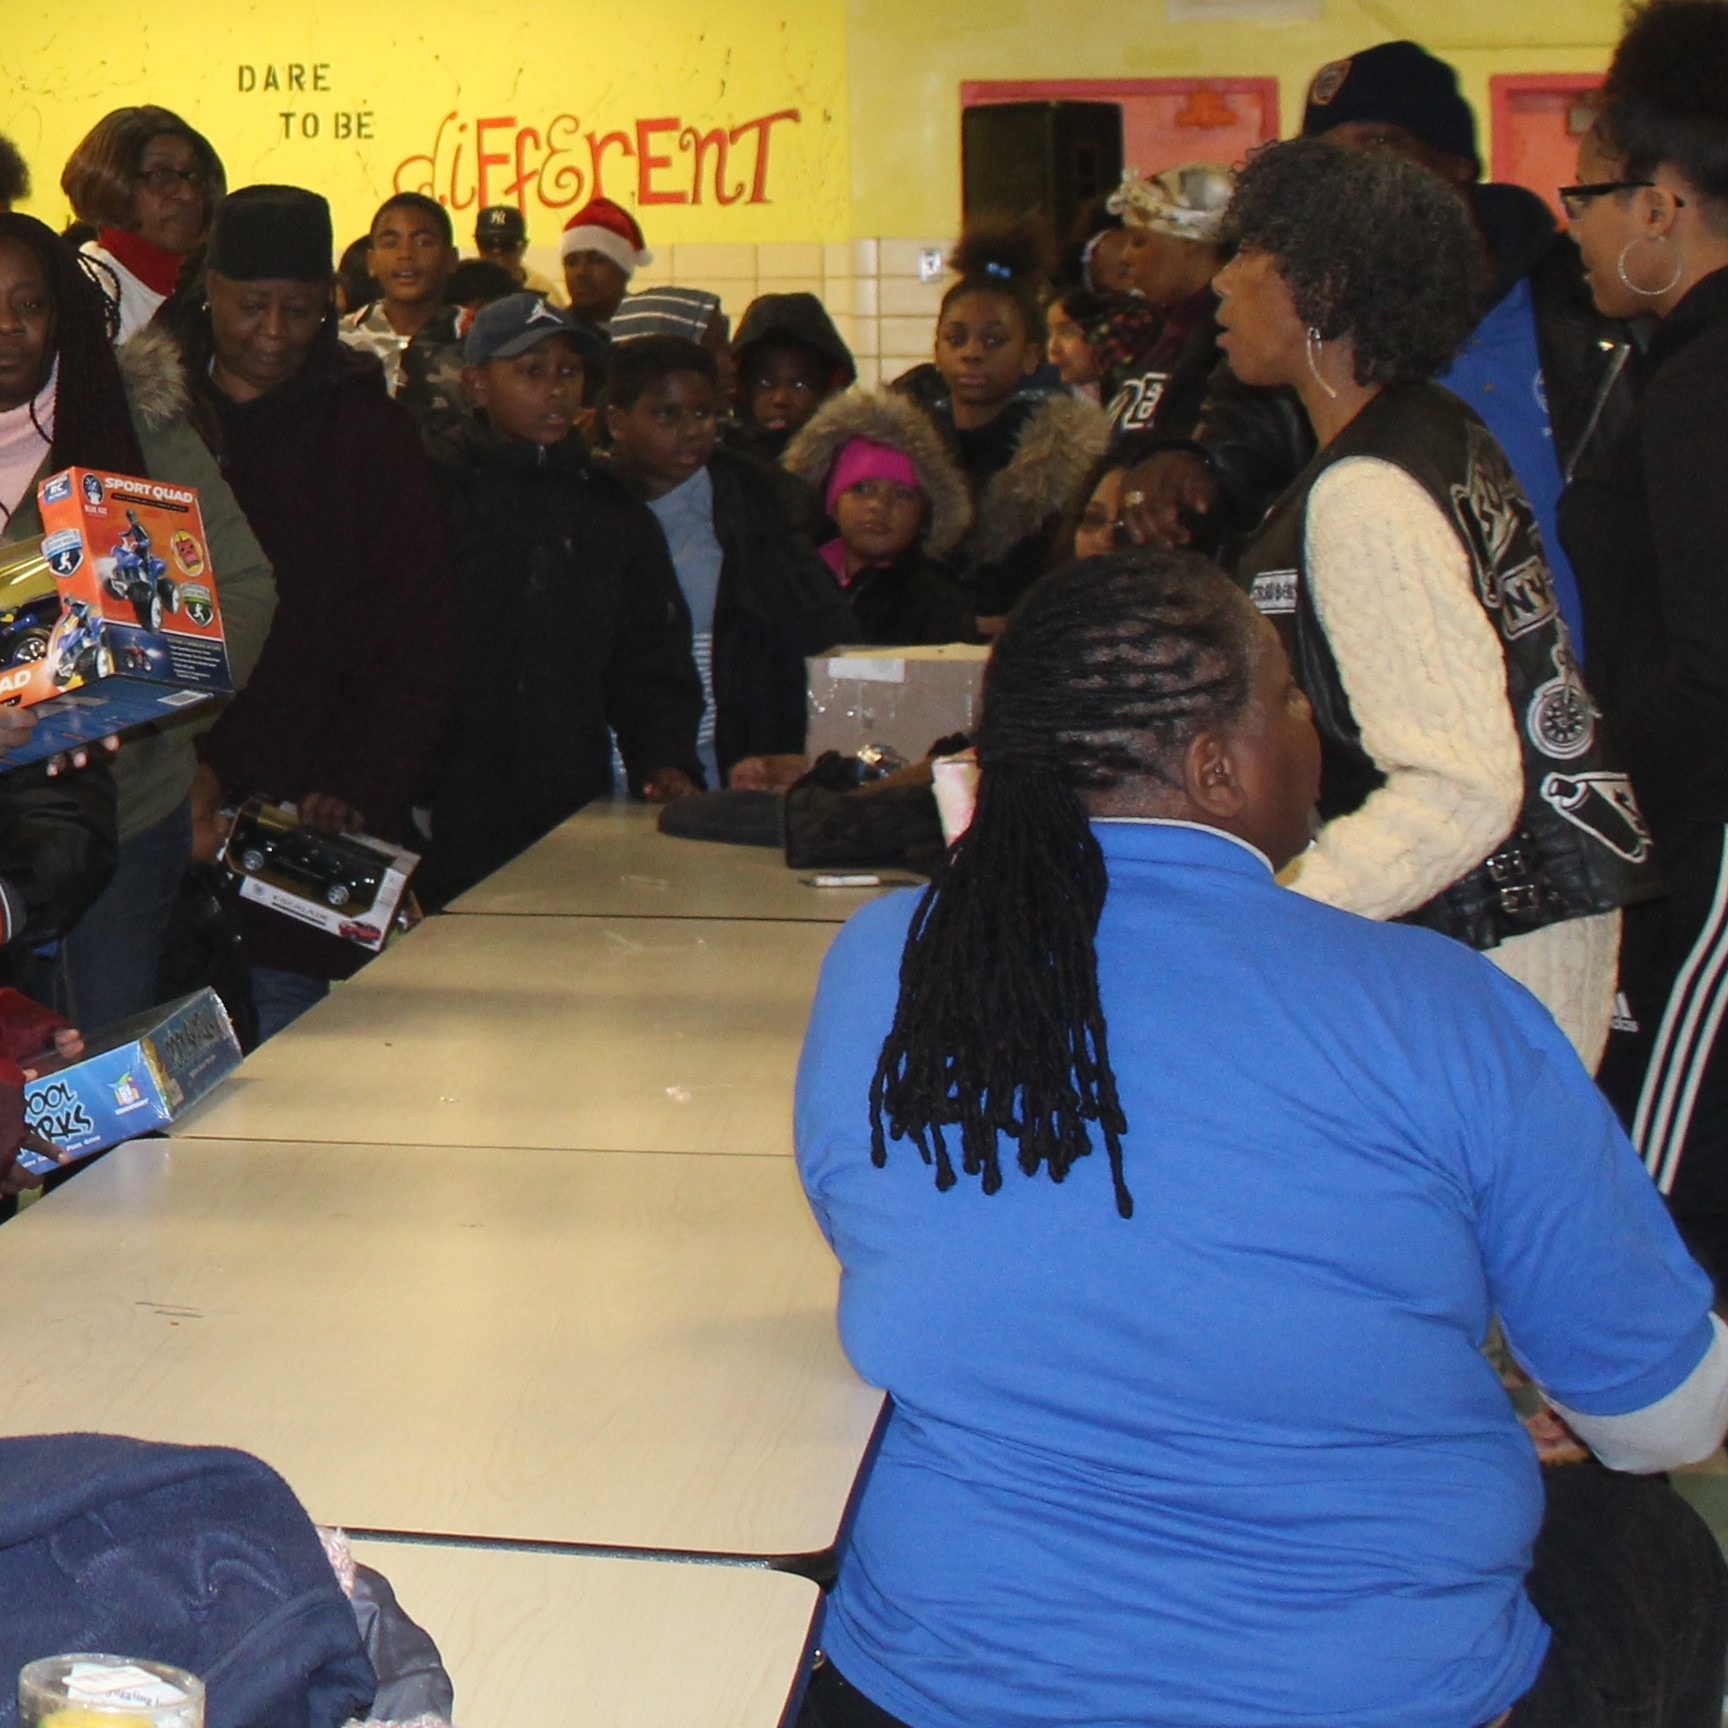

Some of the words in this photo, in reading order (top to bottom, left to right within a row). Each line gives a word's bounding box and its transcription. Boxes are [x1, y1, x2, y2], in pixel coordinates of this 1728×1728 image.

[238, 63, 331, 92] DARE
[279, 111, 320, 140] TO
[334, 111, 374, 140] BE
[104, 476, 153, 495] SPORT
[152, 485, 194, 503] QUAD
[25, 1082, 76, 1116] OOL
